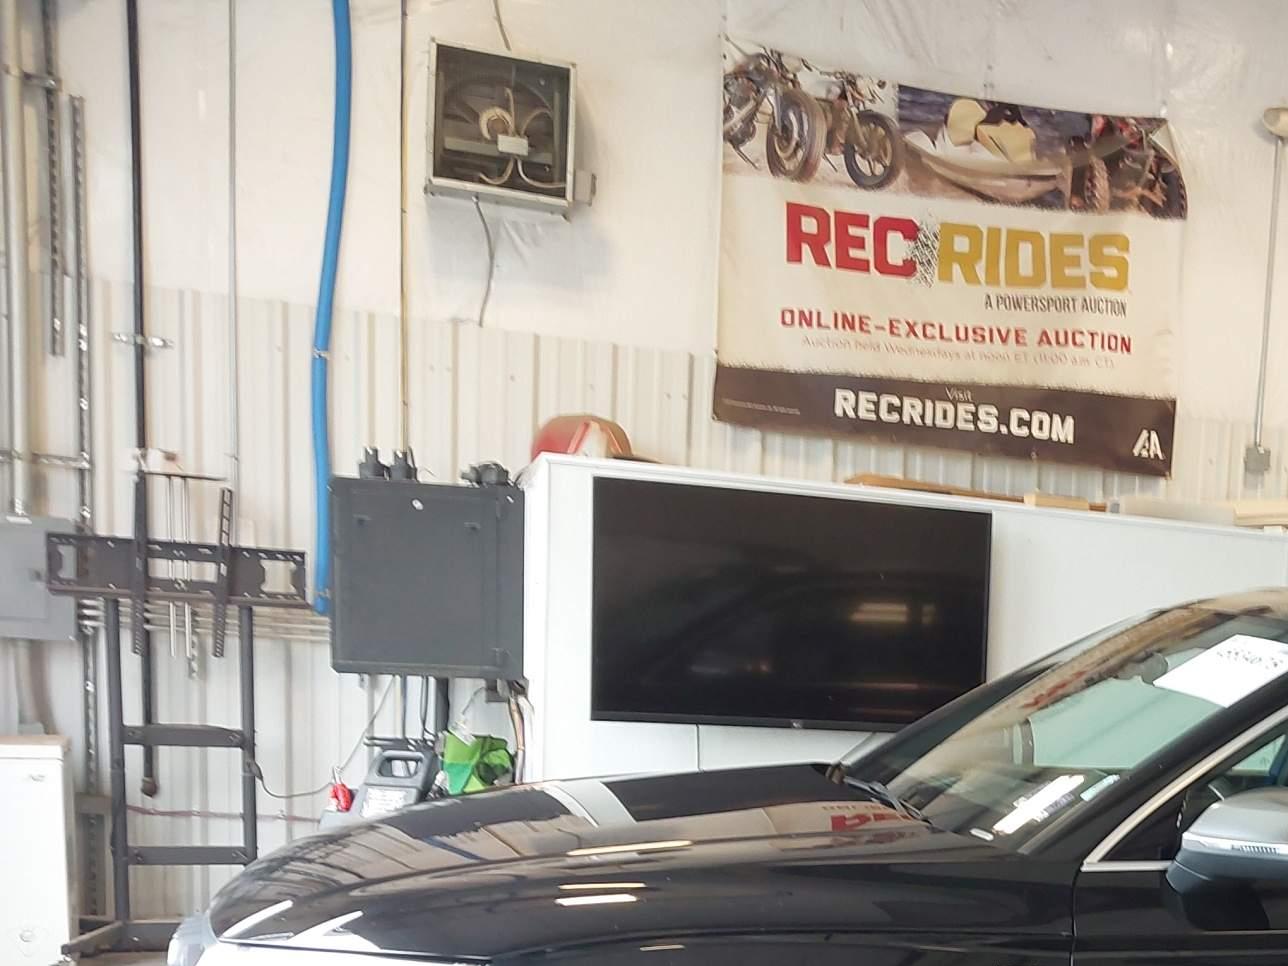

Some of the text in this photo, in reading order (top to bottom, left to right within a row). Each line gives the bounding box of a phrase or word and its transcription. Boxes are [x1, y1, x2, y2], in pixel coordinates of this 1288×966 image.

[786, 202, 1131, 291] REC RIDES
[780, 308, 1132, 354] ONLINE-EXCLUSIVE AUCTION
[985, 293, 1127, 318] A POWERSPORT AUCTION
[834, 387, 1075, 445] RECRIDES.COM
